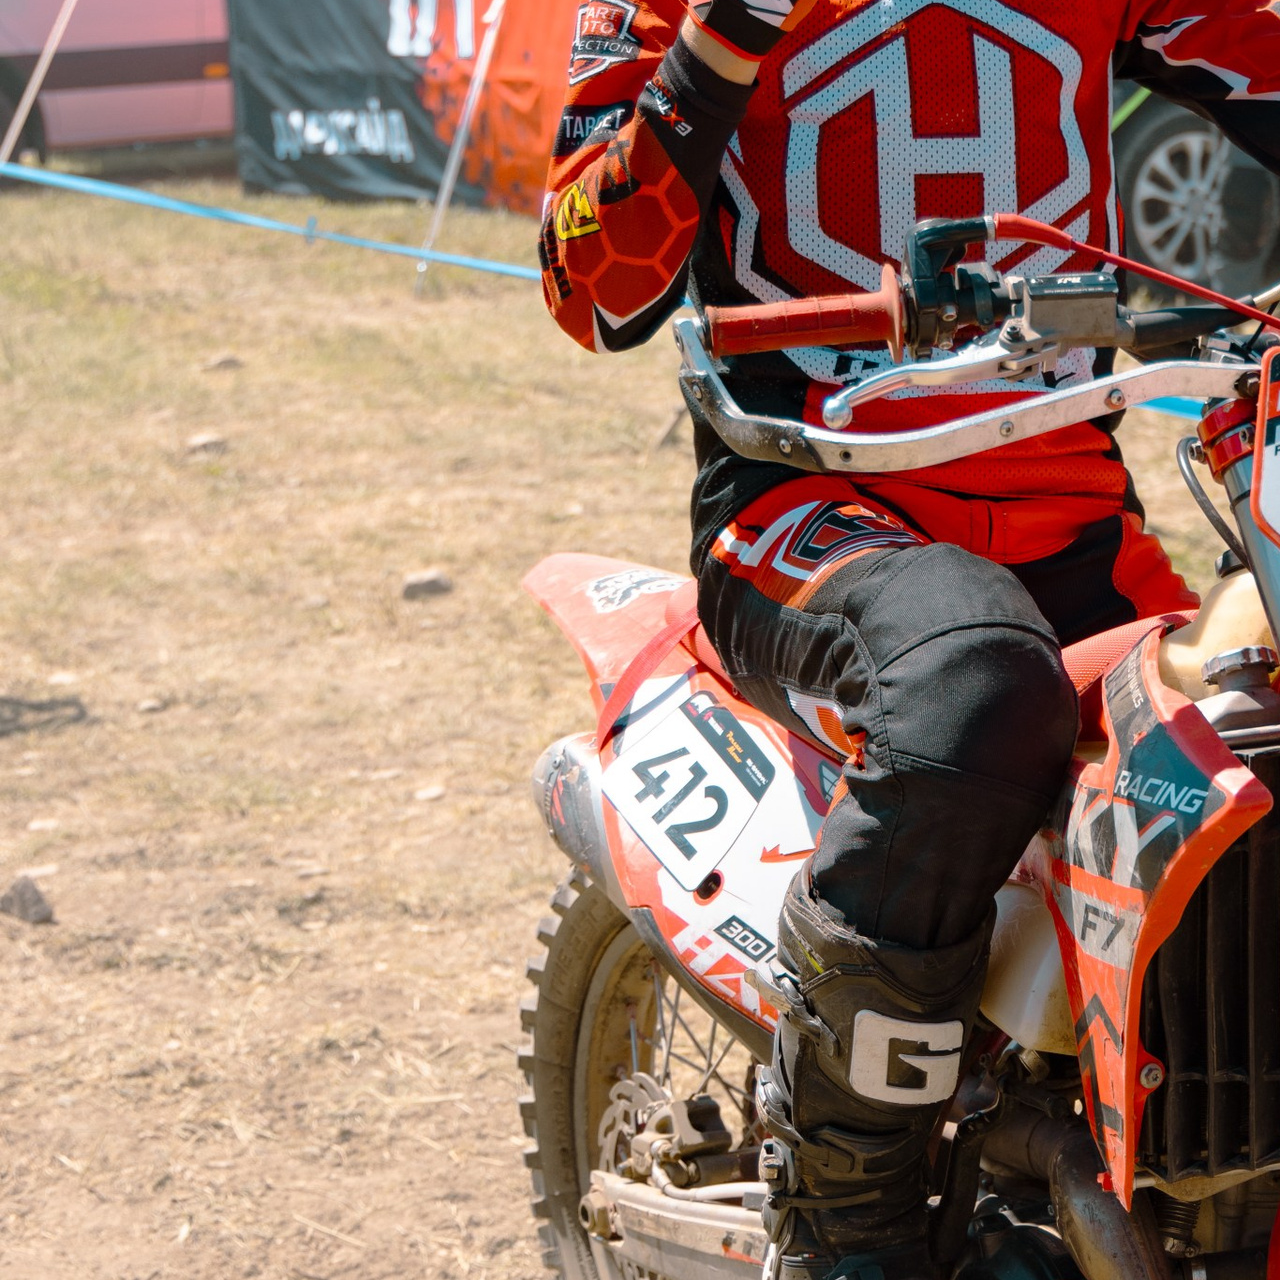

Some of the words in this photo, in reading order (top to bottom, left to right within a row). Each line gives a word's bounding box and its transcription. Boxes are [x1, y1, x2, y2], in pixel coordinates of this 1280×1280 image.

[573, 38, 634, 55] ECTION
[631, 746, 729, 862] 412
[1114, 769, 1209, 814] RACING
[721, 920, 768, 957] 300
[1080, 903, 1126, 951] F7
[849, 1008, 965, 1105] G
